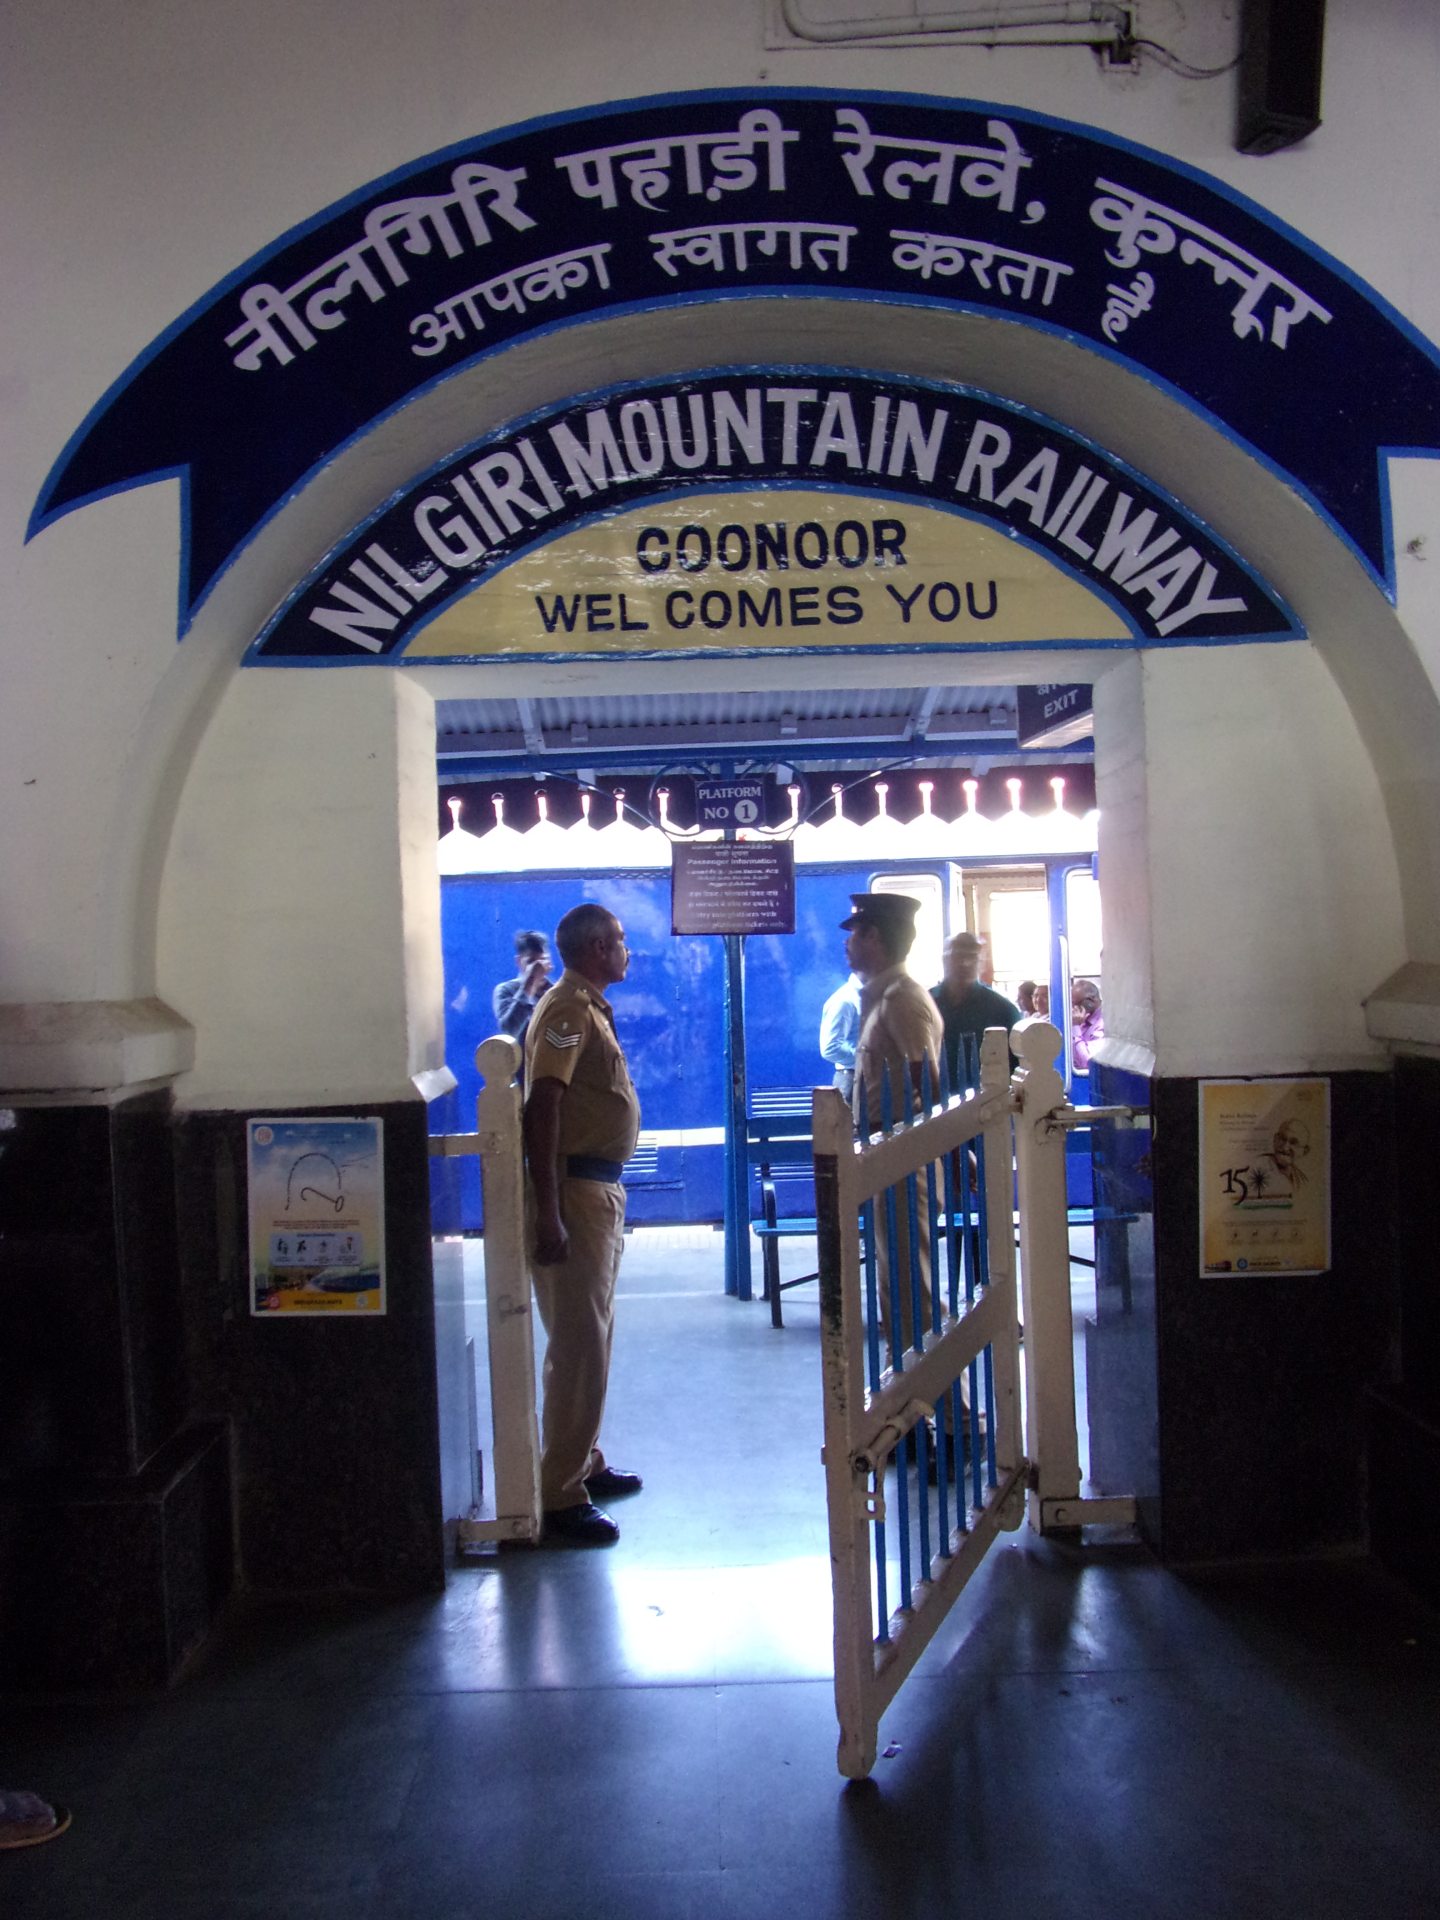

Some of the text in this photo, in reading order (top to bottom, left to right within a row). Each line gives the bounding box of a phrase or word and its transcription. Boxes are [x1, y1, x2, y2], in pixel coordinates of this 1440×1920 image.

[224, 163, 538, 370] नीलगिरि
[554, 108, 800, 212] पहाड़ी
[1089, 176, 1334, 350] कुन्नूर
[409, 222, 1155, 357] आपका स्वागत करता है
[309, 387, 1248, 653] NILGIRI MOUNTAIN RAILWAY
[636, 519, 908, 574] COONOOR
[885, 580, 998, 623] YOU
[1044, 689, 1078, 719] EXIT
[699, 787, 761, 799] PLATFORM
[704, 807, 729, 819] NO
